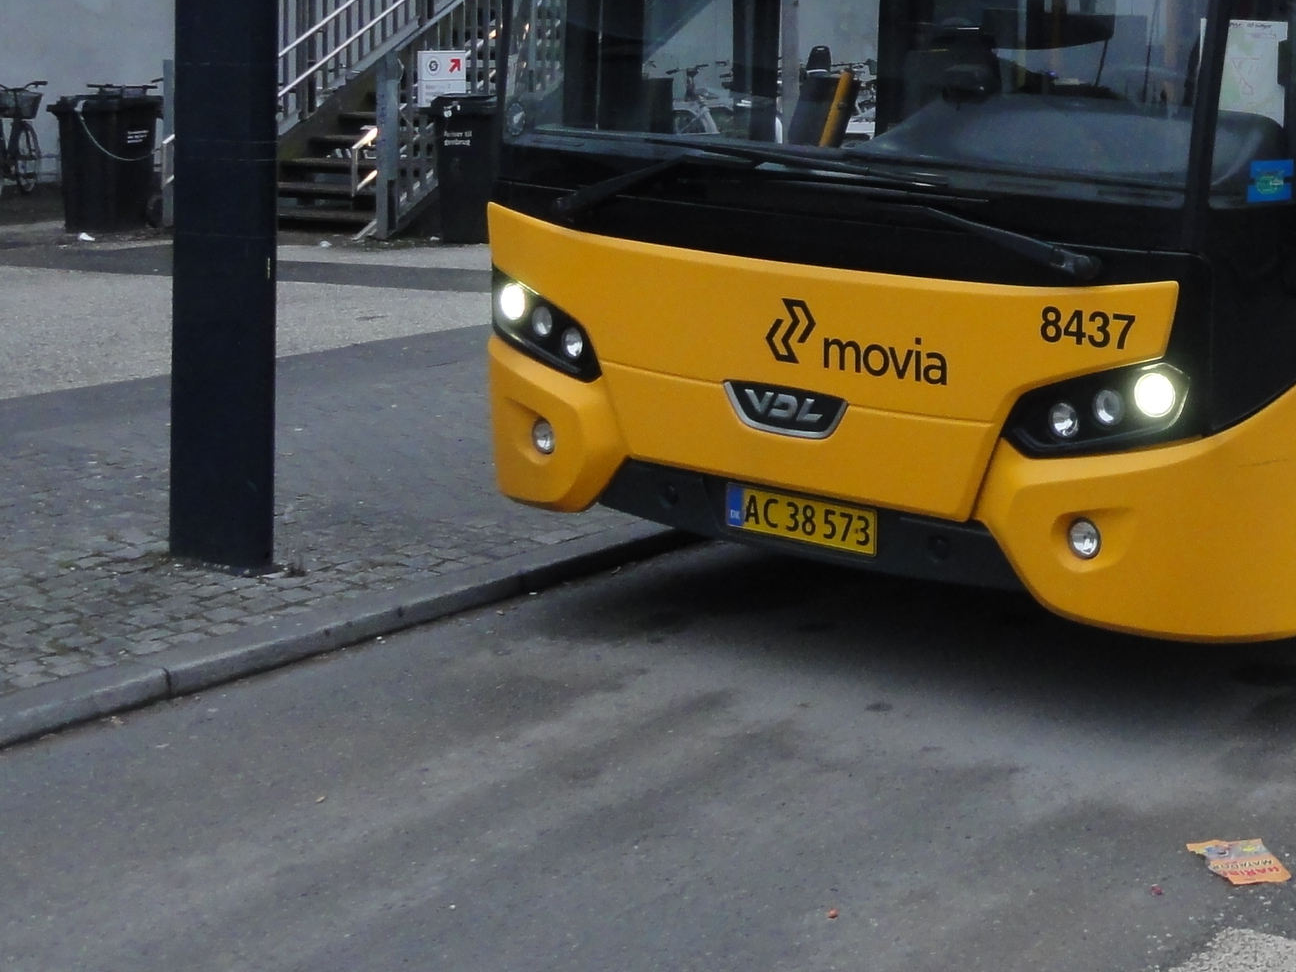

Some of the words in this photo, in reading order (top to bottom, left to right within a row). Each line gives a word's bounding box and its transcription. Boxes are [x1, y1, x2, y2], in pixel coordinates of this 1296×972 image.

[1040, 306, 1136, 350] 8437
[822, 335, 949, 386] movia
[745, 388, 823, 423] VDL
[730, 509, 741, 520] DK
[745, 495, 779, 528] AC
[786, 501, 817, 536] 38
[823, 509, 870, 546] 573
